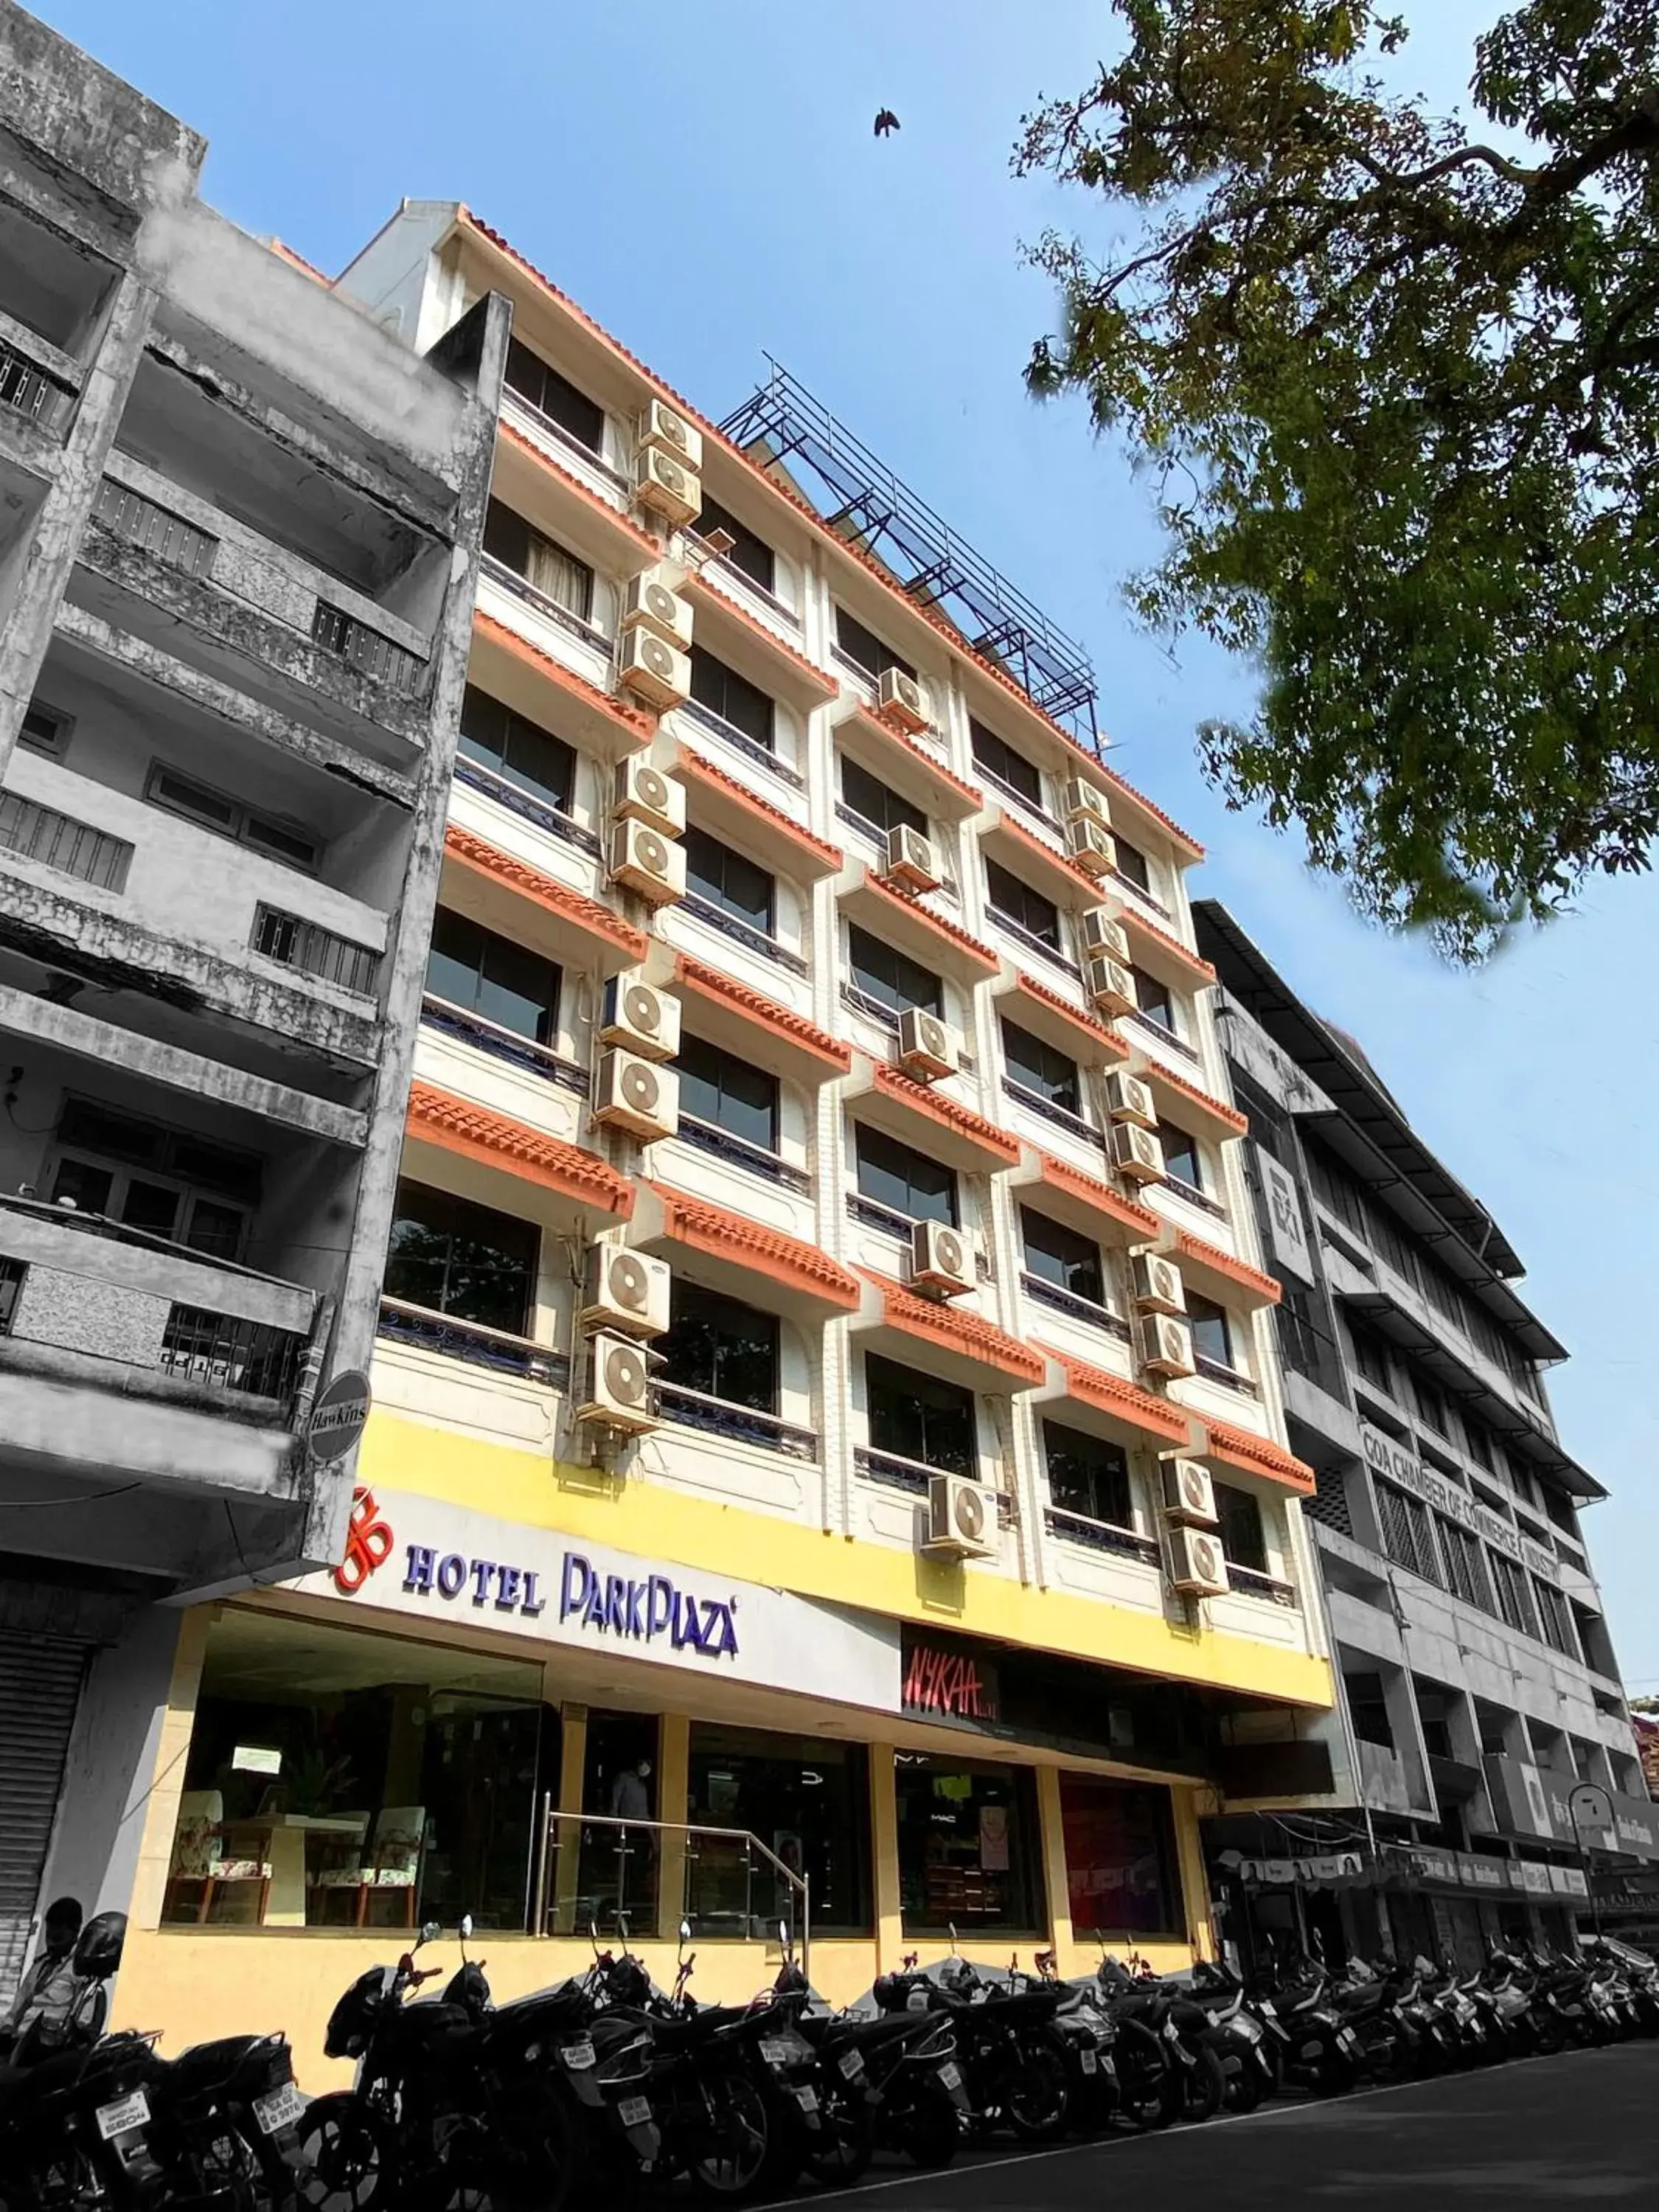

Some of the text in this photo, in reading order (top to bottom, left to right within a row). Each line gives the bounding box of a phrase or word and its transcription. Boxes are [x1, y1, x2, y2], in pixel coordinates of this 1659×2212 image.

[310, 1405, 366, 1431] Hawkins
[1364, 1431, 1393, 1476] GOA
[402, 1545, 546, 1617] HOTEL
[905, 1647, 984, 1716] NYKAA
